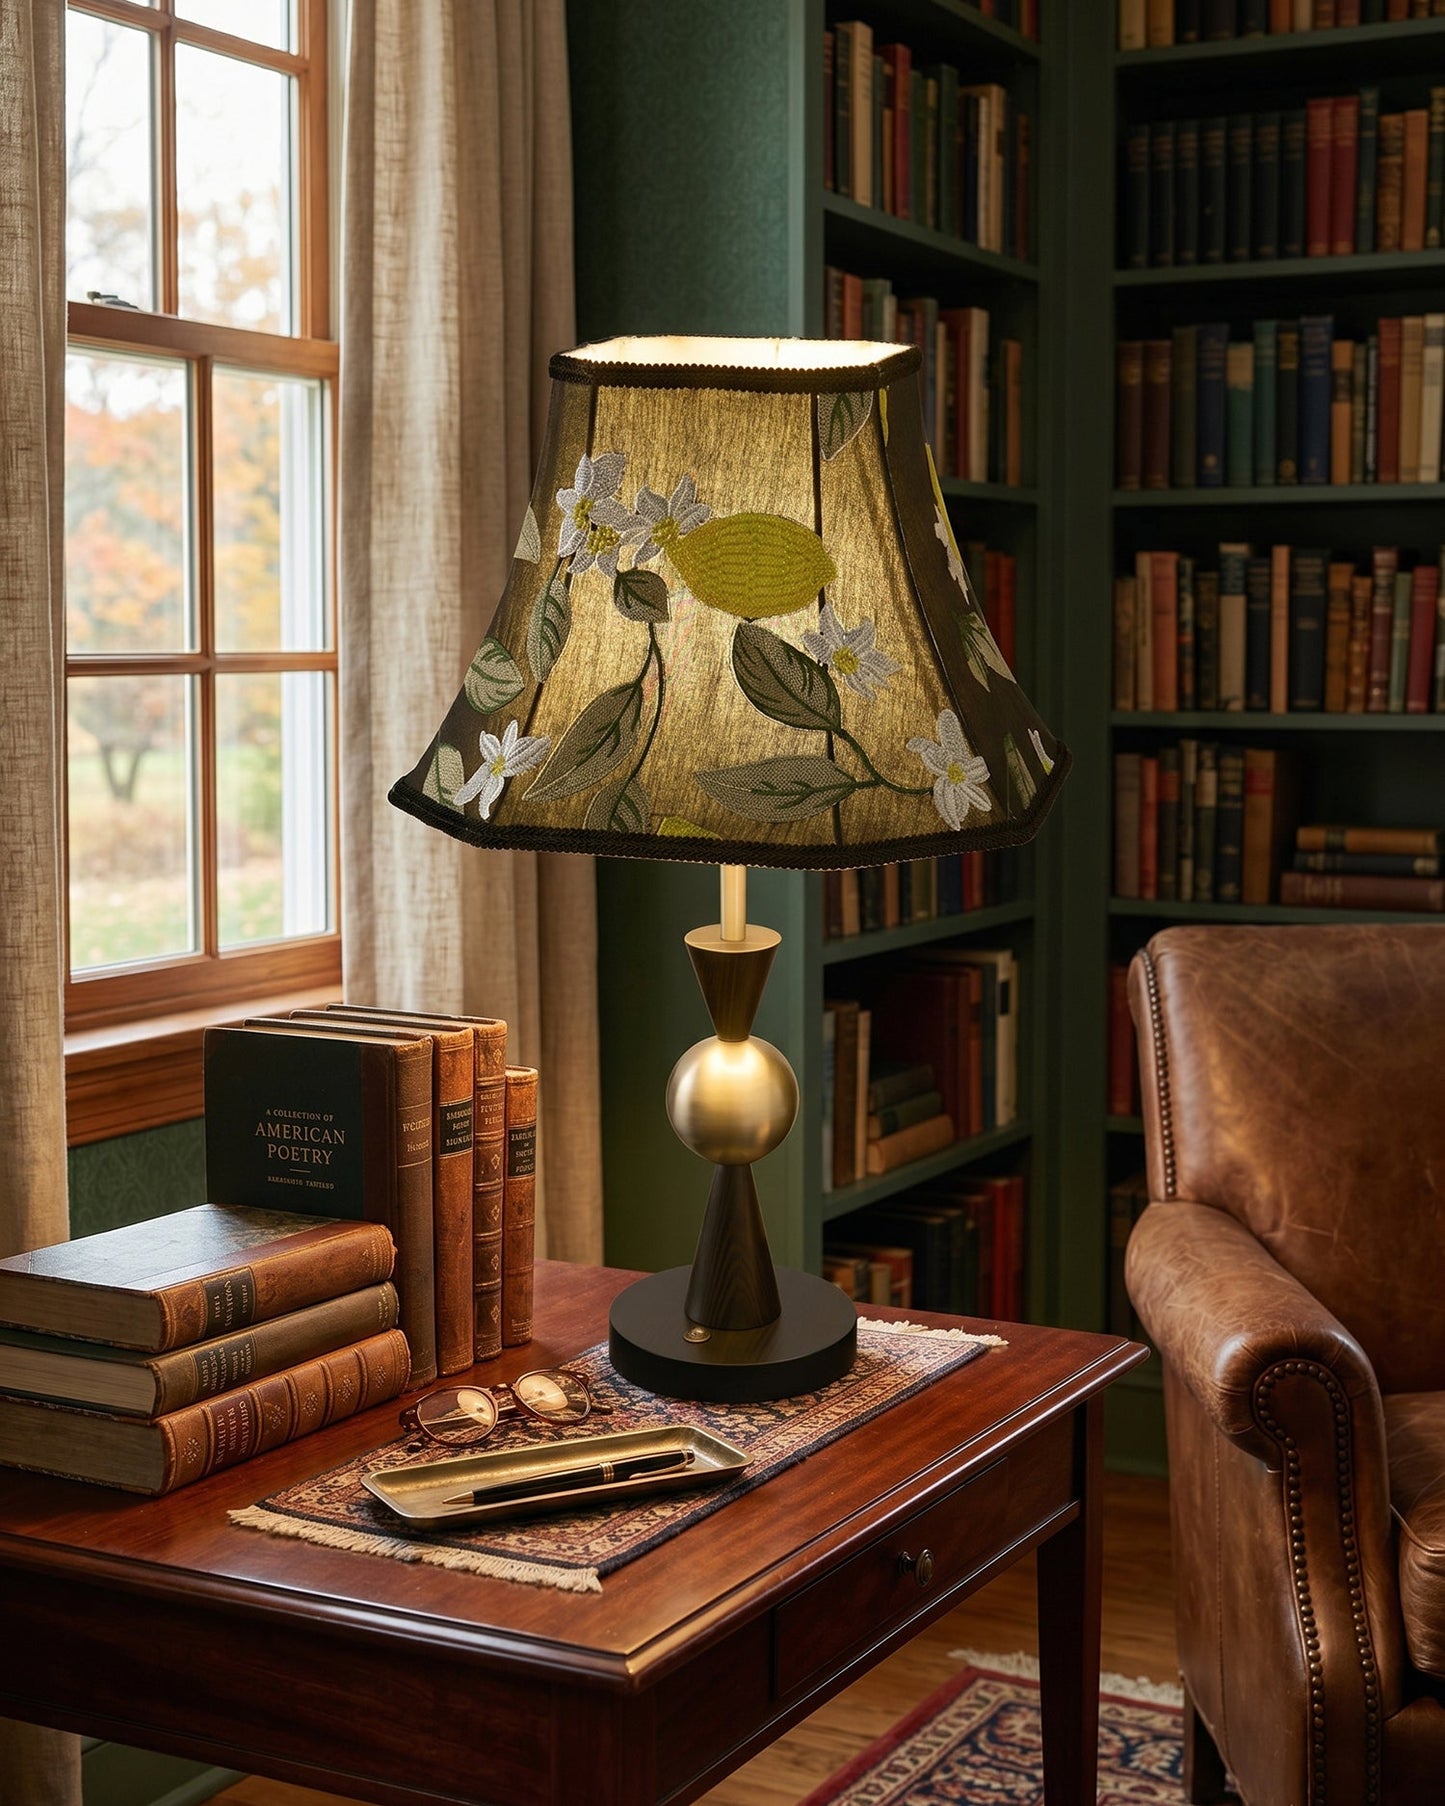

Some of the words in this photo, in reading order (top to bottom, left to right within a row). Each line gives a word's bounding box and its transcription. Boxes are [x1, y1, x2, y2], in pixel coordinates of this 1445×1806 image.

[273, 1109, 321, 1121] COLLECTION
[323, 1114, 334, 1122] OF
[255, 1122, 346, 1145] AMERICAN
[268, 1144, 333, 1165] POETRY
